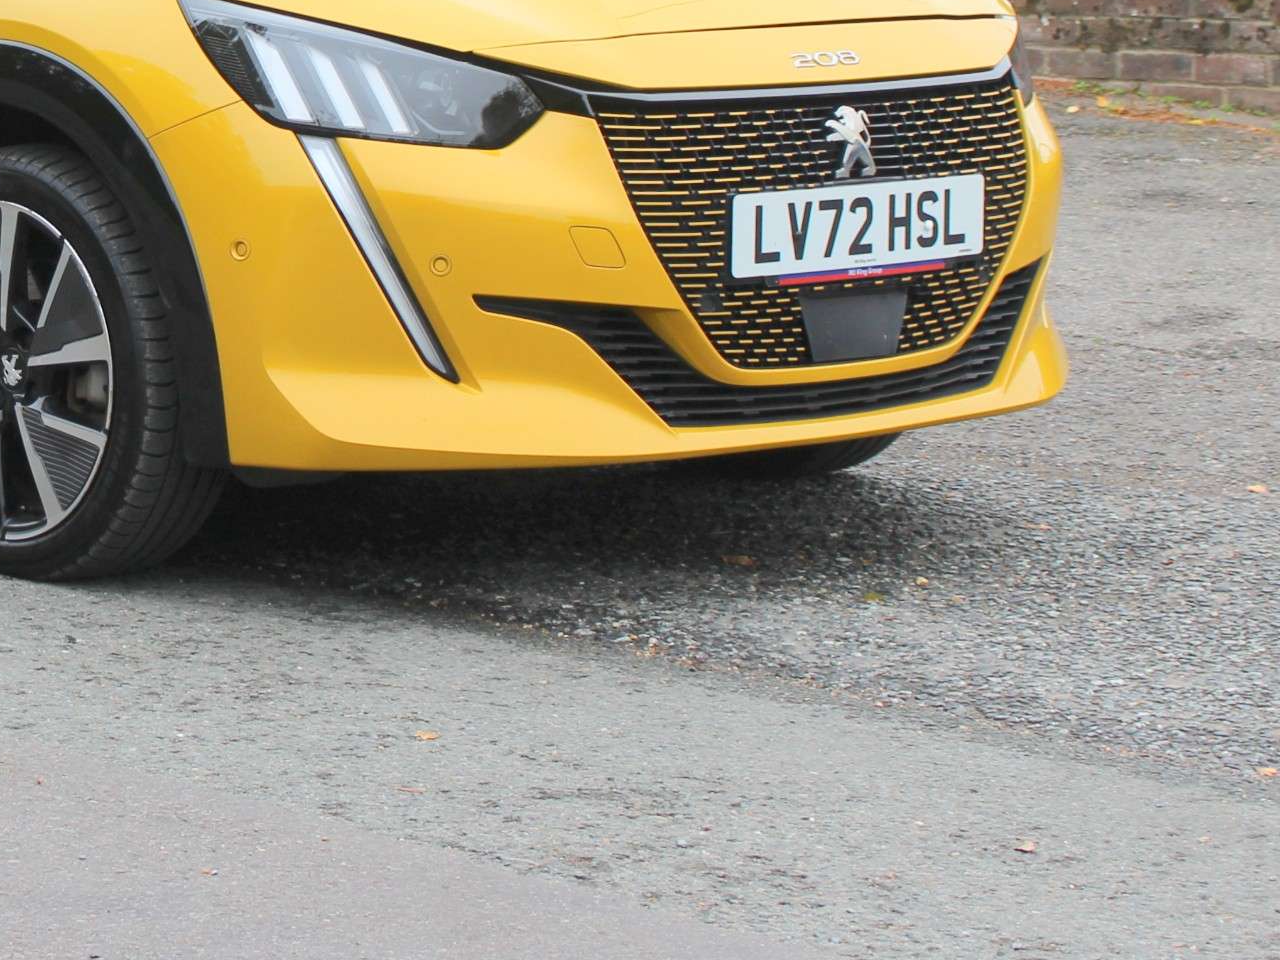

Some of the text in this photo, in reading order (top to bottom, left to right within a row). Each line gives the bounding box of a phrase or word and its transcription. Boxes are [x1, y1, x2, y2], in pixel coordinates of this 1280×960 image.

[791, 50, 860, 69] 208
[754, 188, 966, 264] LV72 HSL
